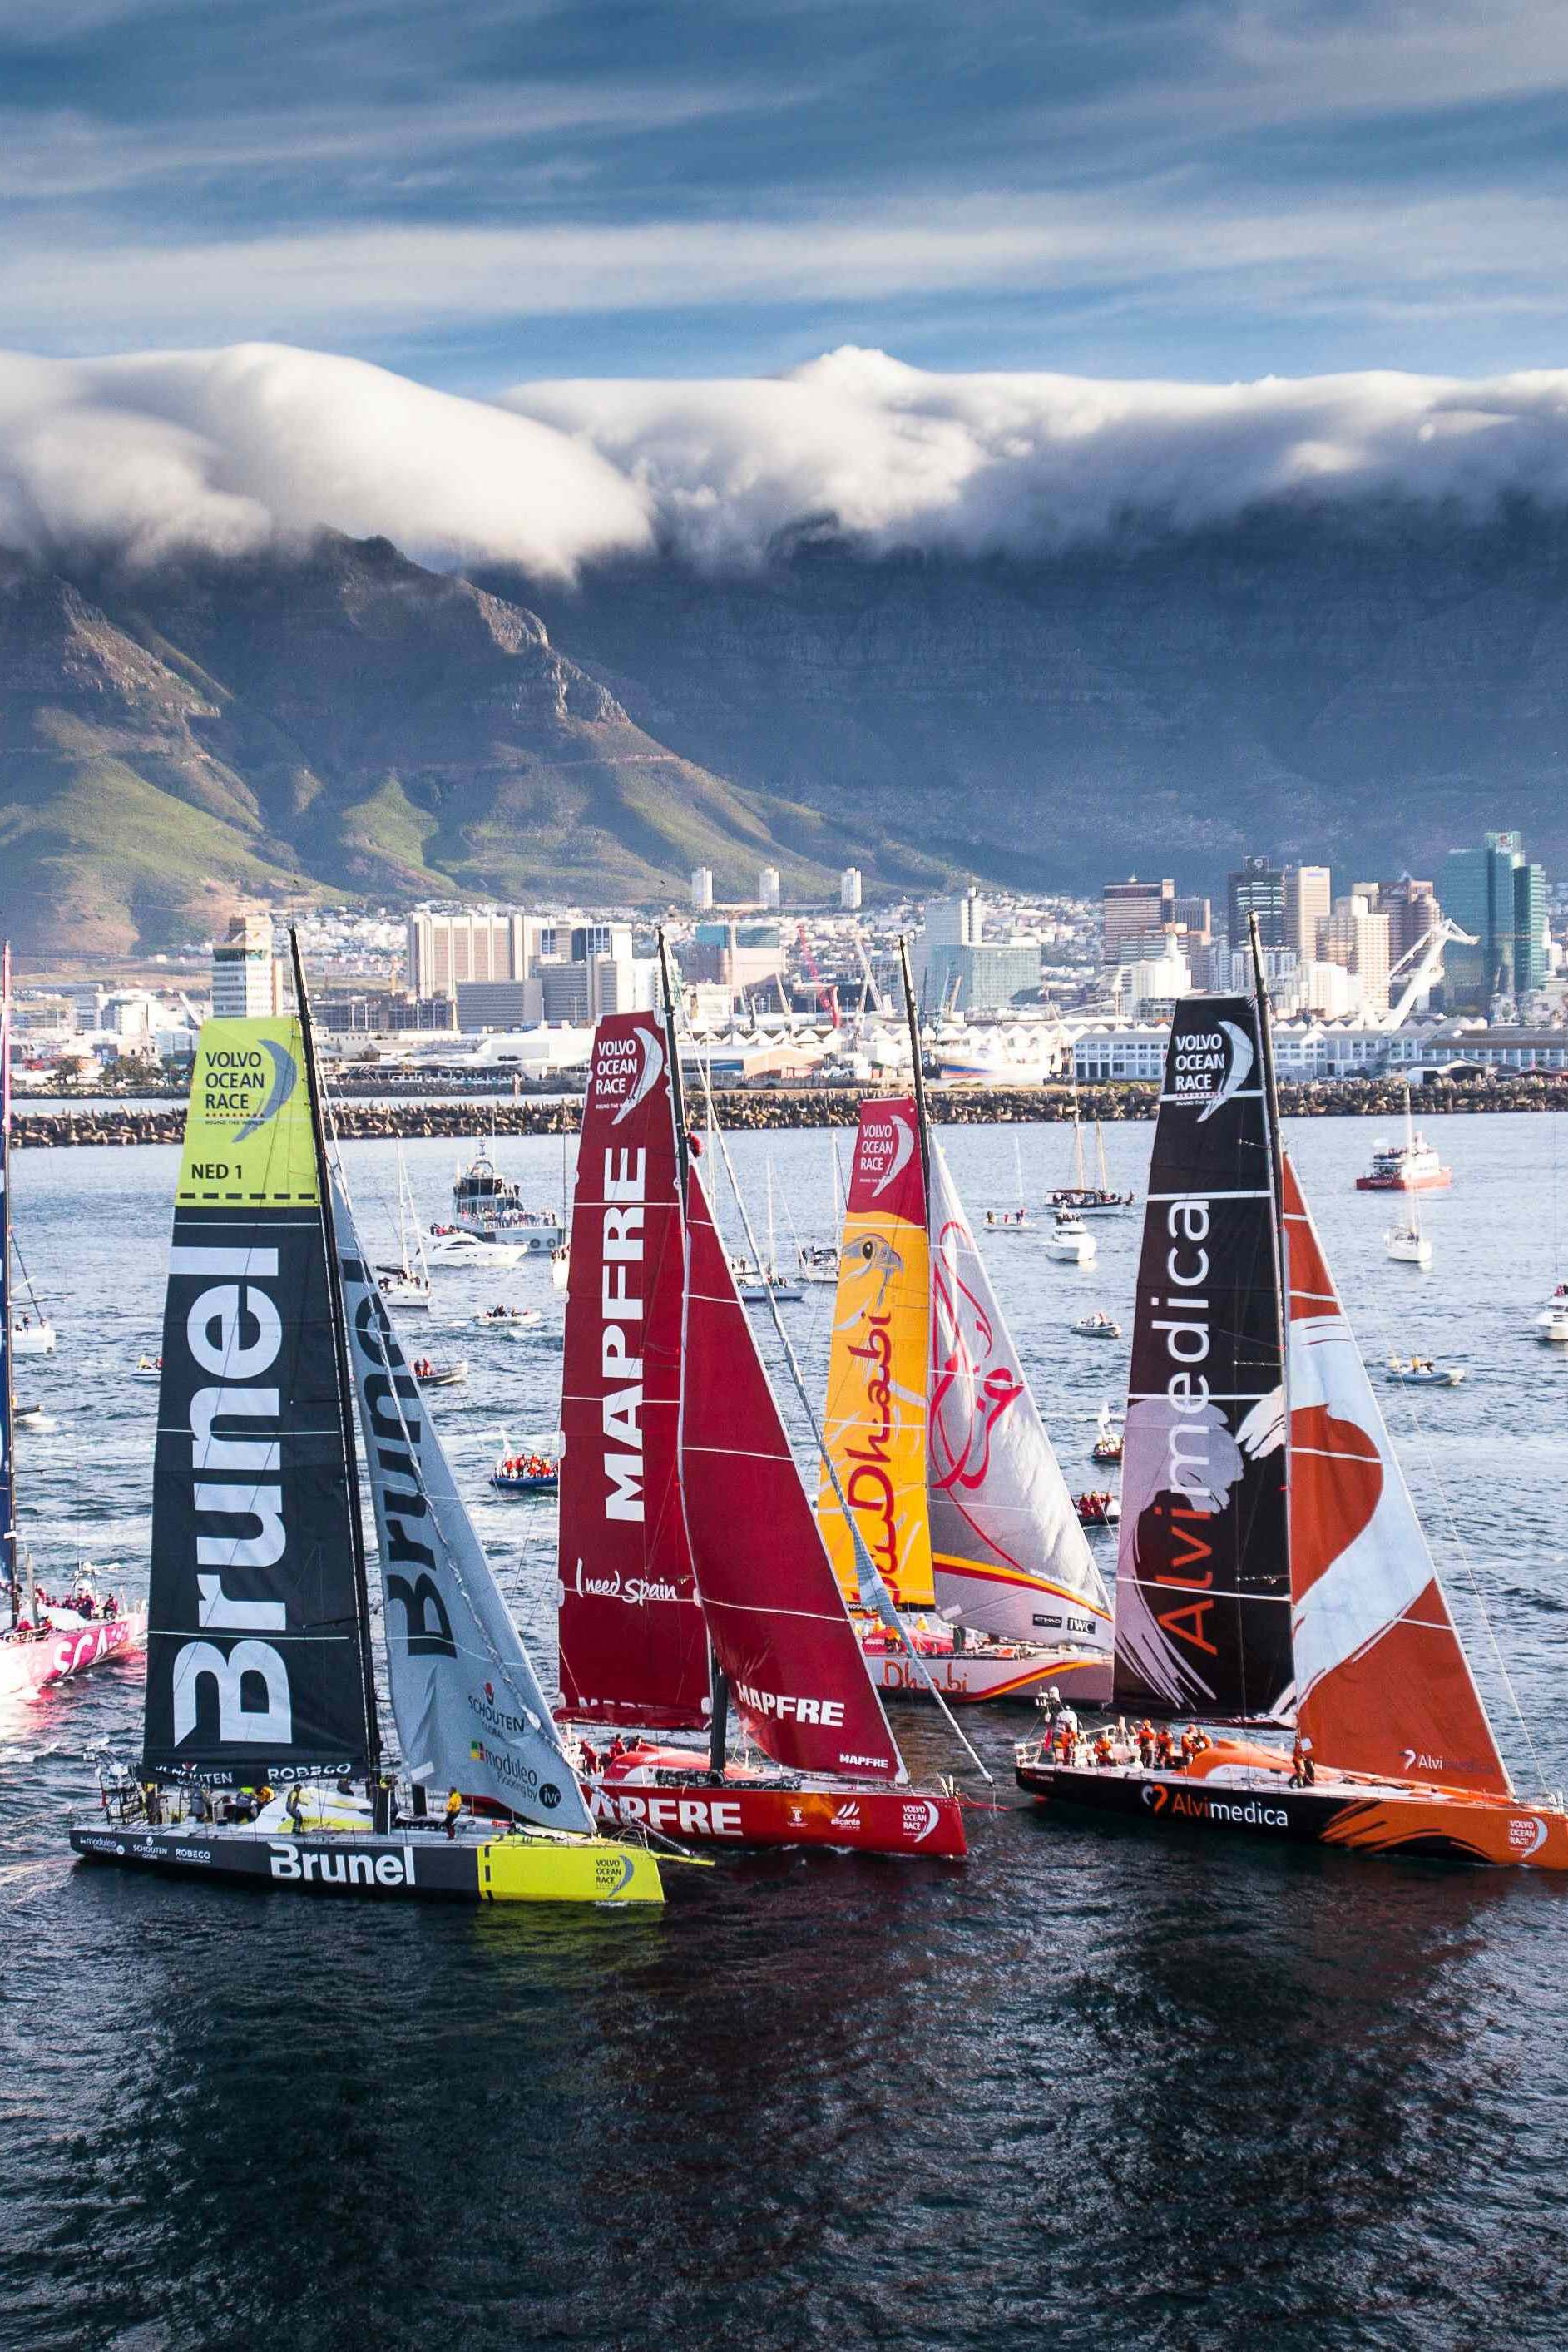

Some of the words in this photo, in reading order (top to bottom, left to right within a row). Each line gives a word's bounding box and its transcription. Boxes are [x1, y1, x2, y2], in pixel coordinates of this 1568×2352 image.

[598, 1039, 636, 1057] VOLVO
[1175, 1034, 1223, 1051] VOLVO
[205, 1052, 262, 1067] VOLVO
[596, 1058, 638, 1076] OCEAN
[1175, 1053, 1225, 1071] OCEAN
[205, 1072, 265, 1088] OCEAN
[596, 1078, 626, 1095] RACE
[1175, 1074, 1212, 1091] RACE
[205, 1093, 249, 1109] RACE
[863, 1124, 893, 1138] VOLVO
[861, 1141, 893, 1155] OCEAN
[191, 1164, 229, 1179] NED
[235, 1165, 242, 1179] 1
[860, 1157, 883, 1171] RACE
[602, 1147, 646, 1522] MAPFRE
[844, 1311, 894, 1519] Dhabi
[1150, 1200, 1218, 1656] Alvimedica
[341, 1258, 458, 1658] Brunel
[169, 1246, 292, 1747] Brunel
[576, 1557, 583, 1597] I
[585, 1570, 620, 1595] need
[1070, 1618, 1094, 1633] IWC
[736, 1681, 844, 1727] MAPFRE
[468, 1695, 525, 1732] SCHOUTEN
[485, 1748, 537, 1787] moduleo
[839, 1753, 888, 1769] MAPFRE
[589, 1793, 744, 1837] APFRE
[903, 1805, 926, 1815] VOLVO
[903, 1813, 927, 1823] OCEAN
[1173, 1793, 1289, 1827] Alvimedica
[903, 1821, 921, 1830] RACE
[1509, 1820, 1534, 1830] VOLVO
[1509, 1830, 1536, 1839] OCEAN
[1509, 1836, 1529, 1845] RACE
[132, 1844, 168, 1855] SCHOUTEN
[176, 1848, 210, 1859] ROBECO
[267, 1843, 416, 1886] Brunel
[596, 1859, 620, 1867] VOLVO
[596, 1868, 621, 1876] OCEAN
[596, 1876, 616, 1884] RACE
